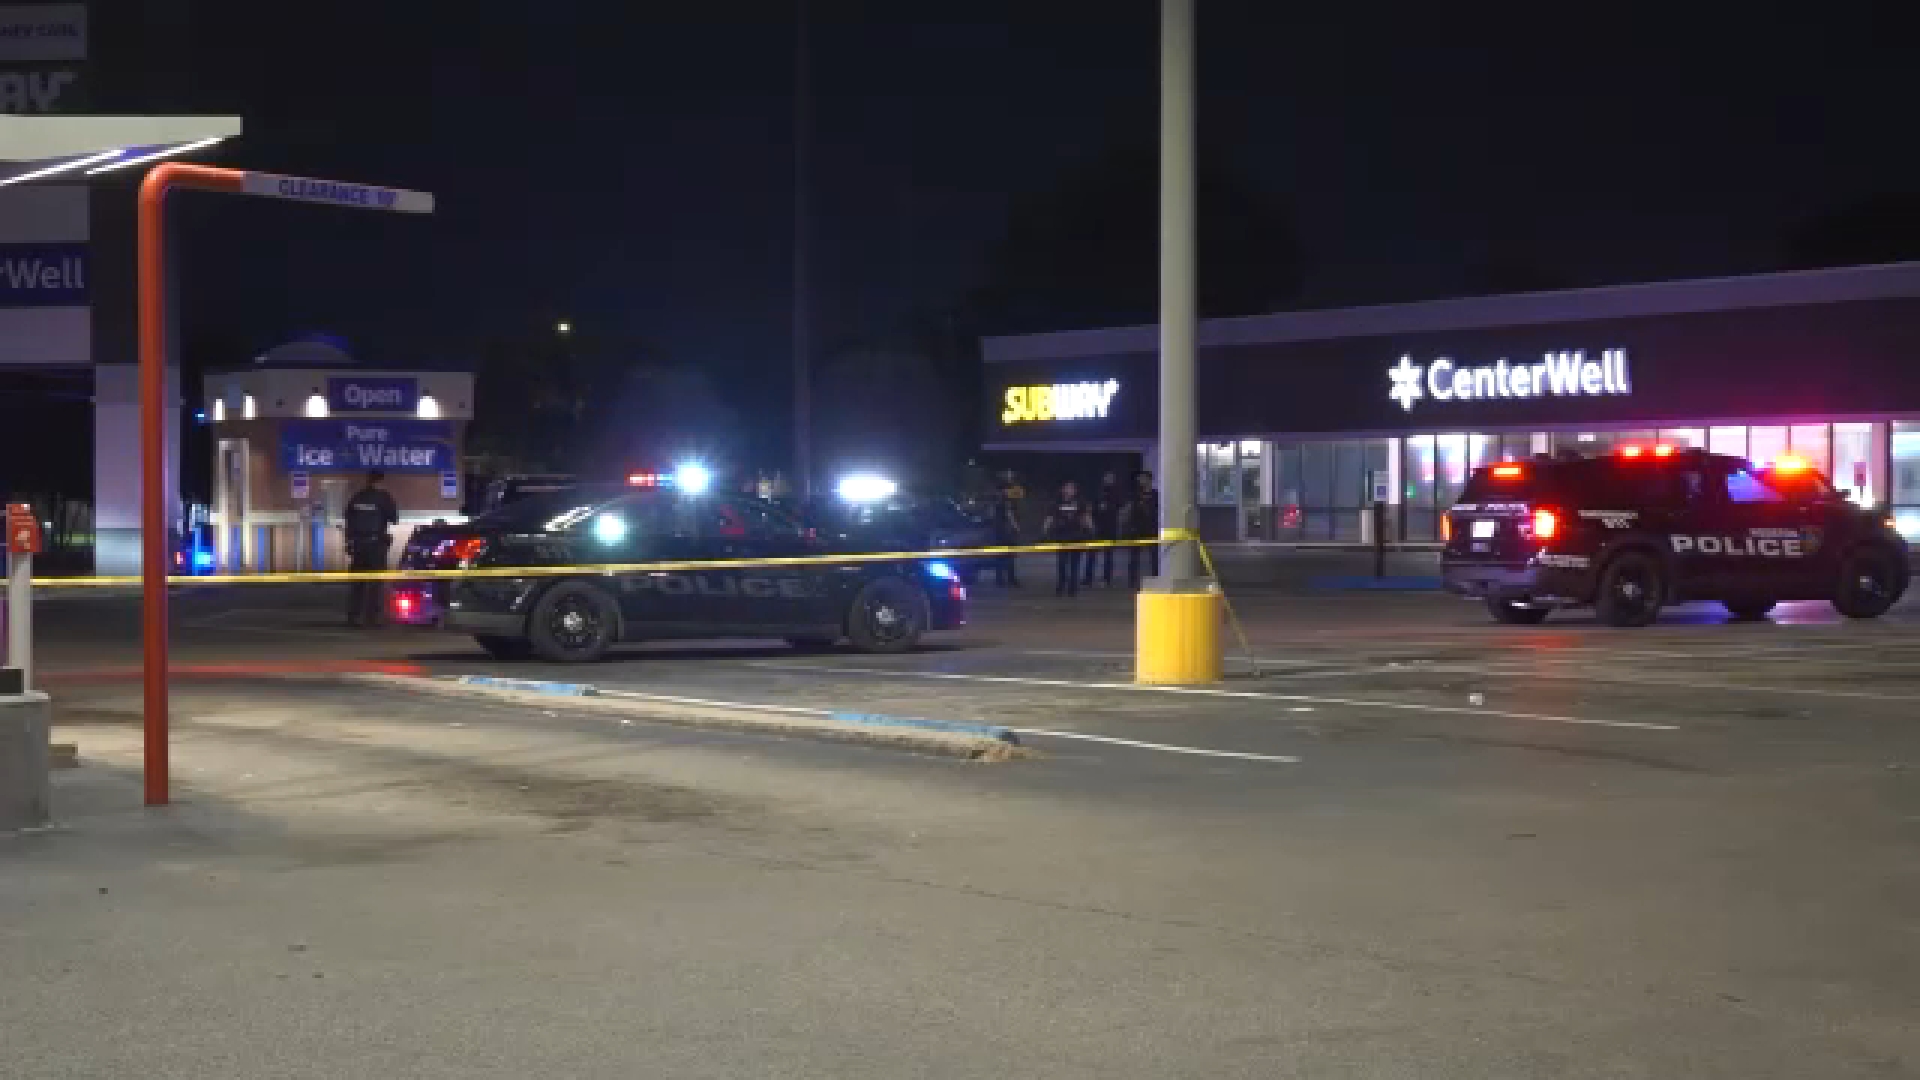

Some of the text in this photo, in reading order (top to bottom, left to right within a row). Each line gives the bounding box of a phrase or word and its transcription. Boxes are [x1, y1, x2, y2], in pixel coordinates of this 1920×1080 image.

[276, 179, 369, 205] CLEARANCE
[1428, 348, 1632, 400] CenterWell
[344, 383, 403, 409] Open
[1002, 378, 1119, 425] SUBWAY
[345, 424, 390, 442] Pure
[296, 443, 436, 466] Ice Water
[1669, 533, 1804, 558] POLICE
[620, 574, 804, 598] POLICE
